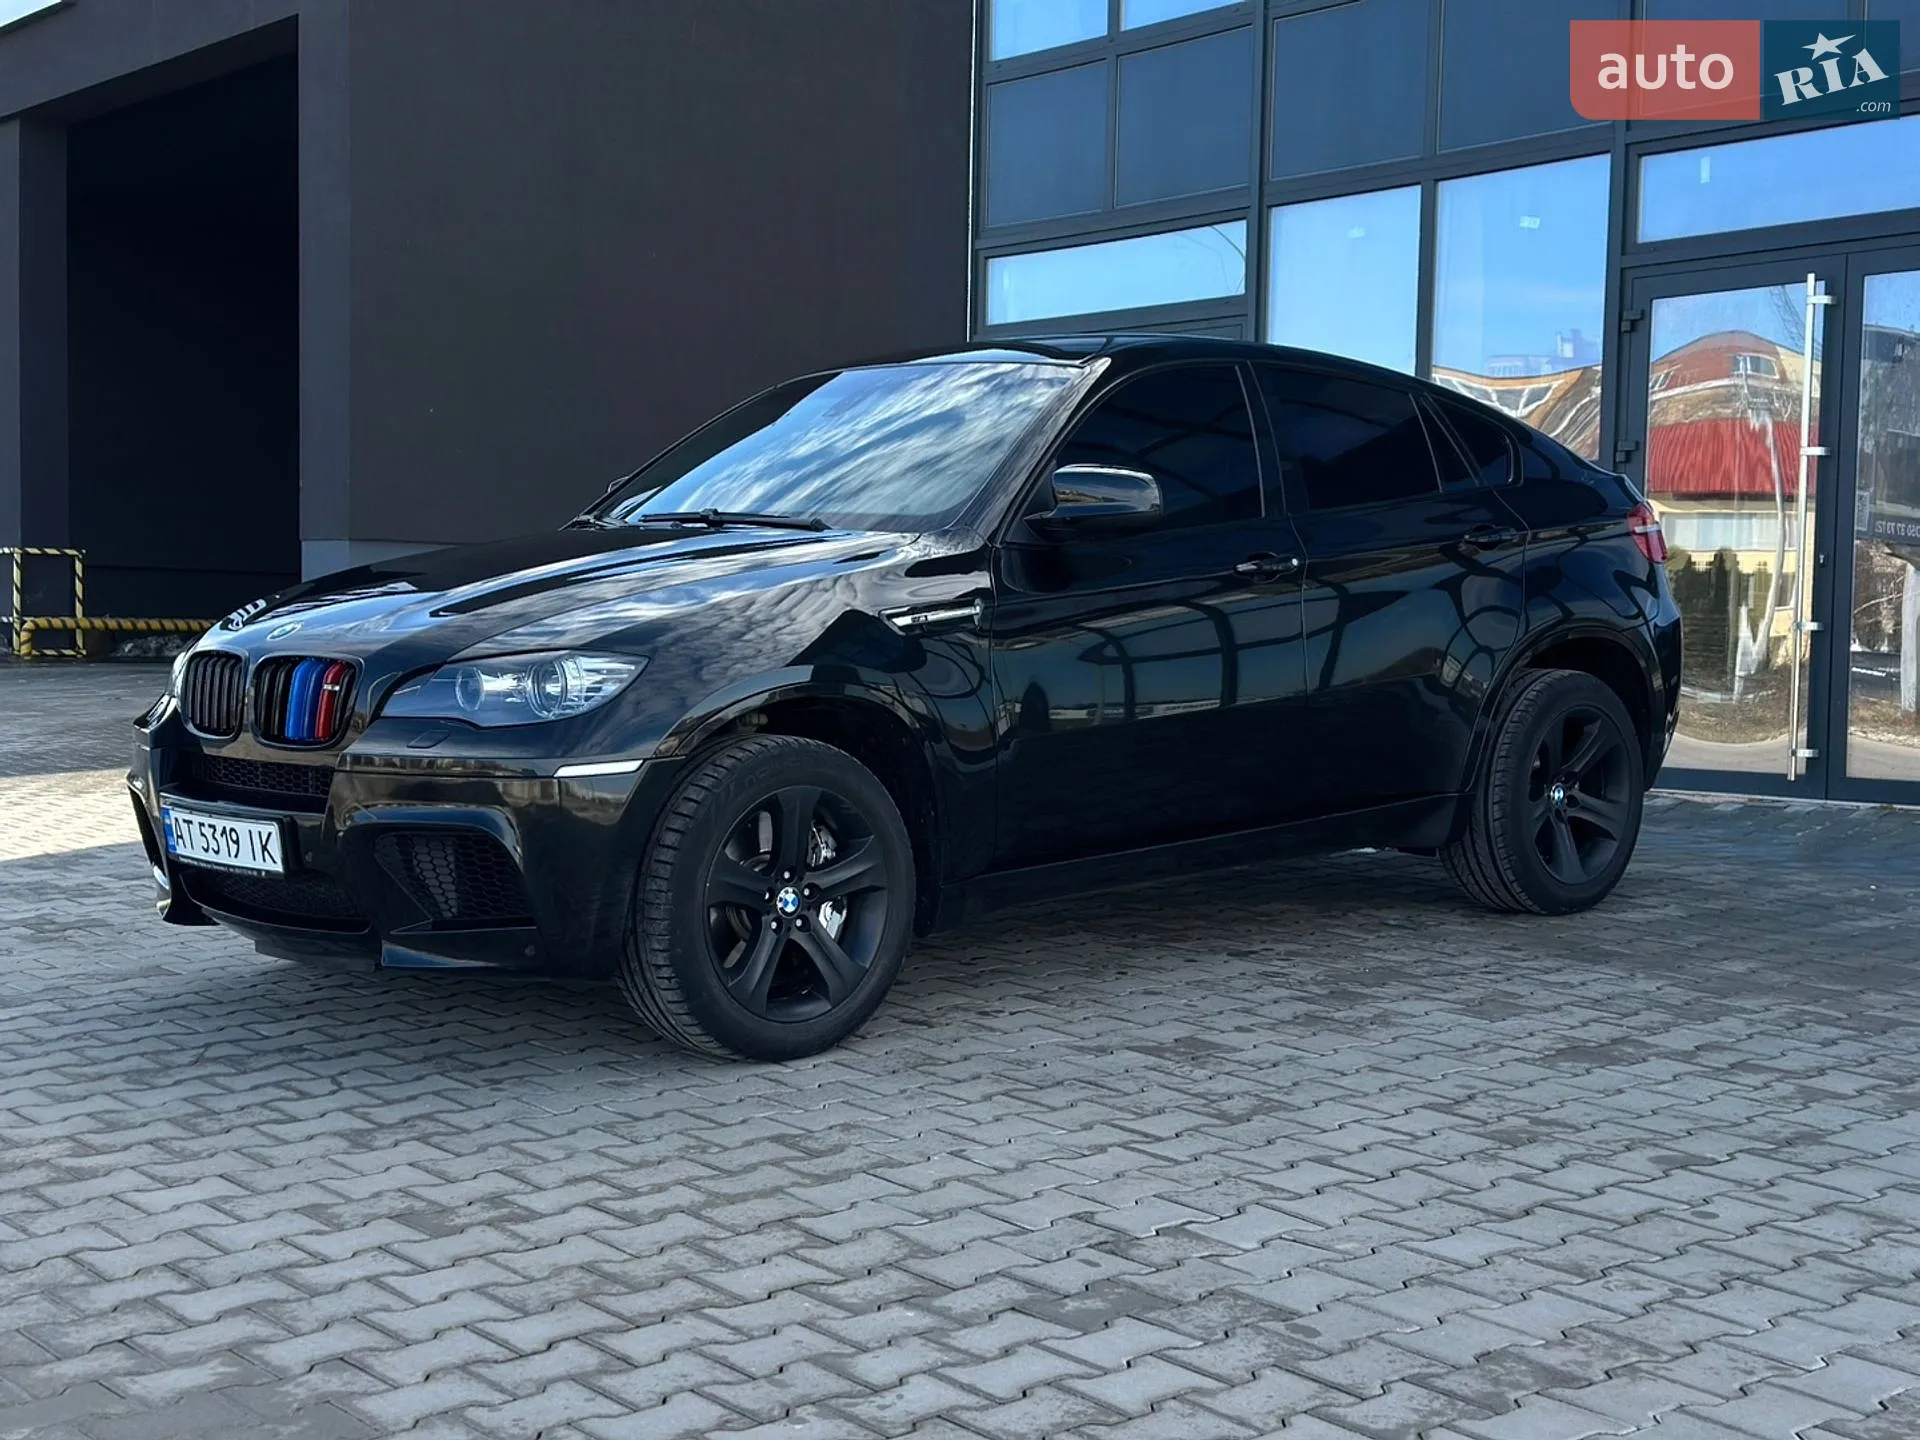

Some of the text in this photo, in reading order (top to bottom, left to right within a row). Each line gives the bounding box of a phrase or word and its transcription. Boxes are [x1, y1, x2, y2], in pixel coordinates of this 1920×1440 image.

[174, 817, 277, 864] AT 5319 IK
